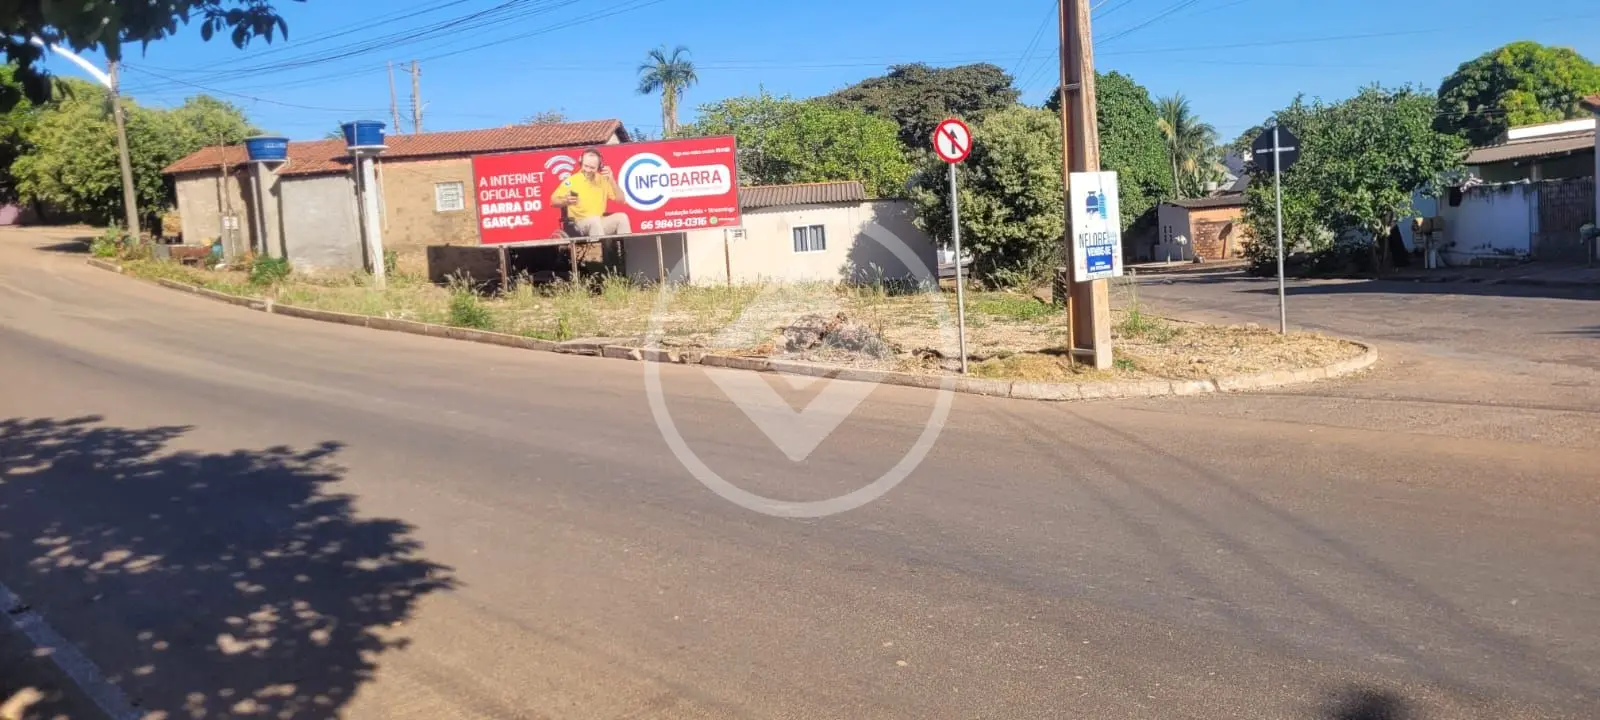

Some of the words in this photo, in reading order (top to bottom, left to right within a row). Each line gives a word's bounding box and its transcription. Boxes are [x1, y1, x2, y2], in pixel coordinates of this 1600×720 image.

[479, 176, 488, 187] A
[489, 171, 545, 187] INTERNET
[635, 169, 722, 190] INFOBARRA
[480, 188, 524, 201] OFICIAL
[525, 185, 542, 198] DE
[481, 201, 523, 215] BARRA
[523, 199, 542, 212] DO
[483, 214, 534, 230] GARÇAS.
[640, 220, 654, 230] 66
